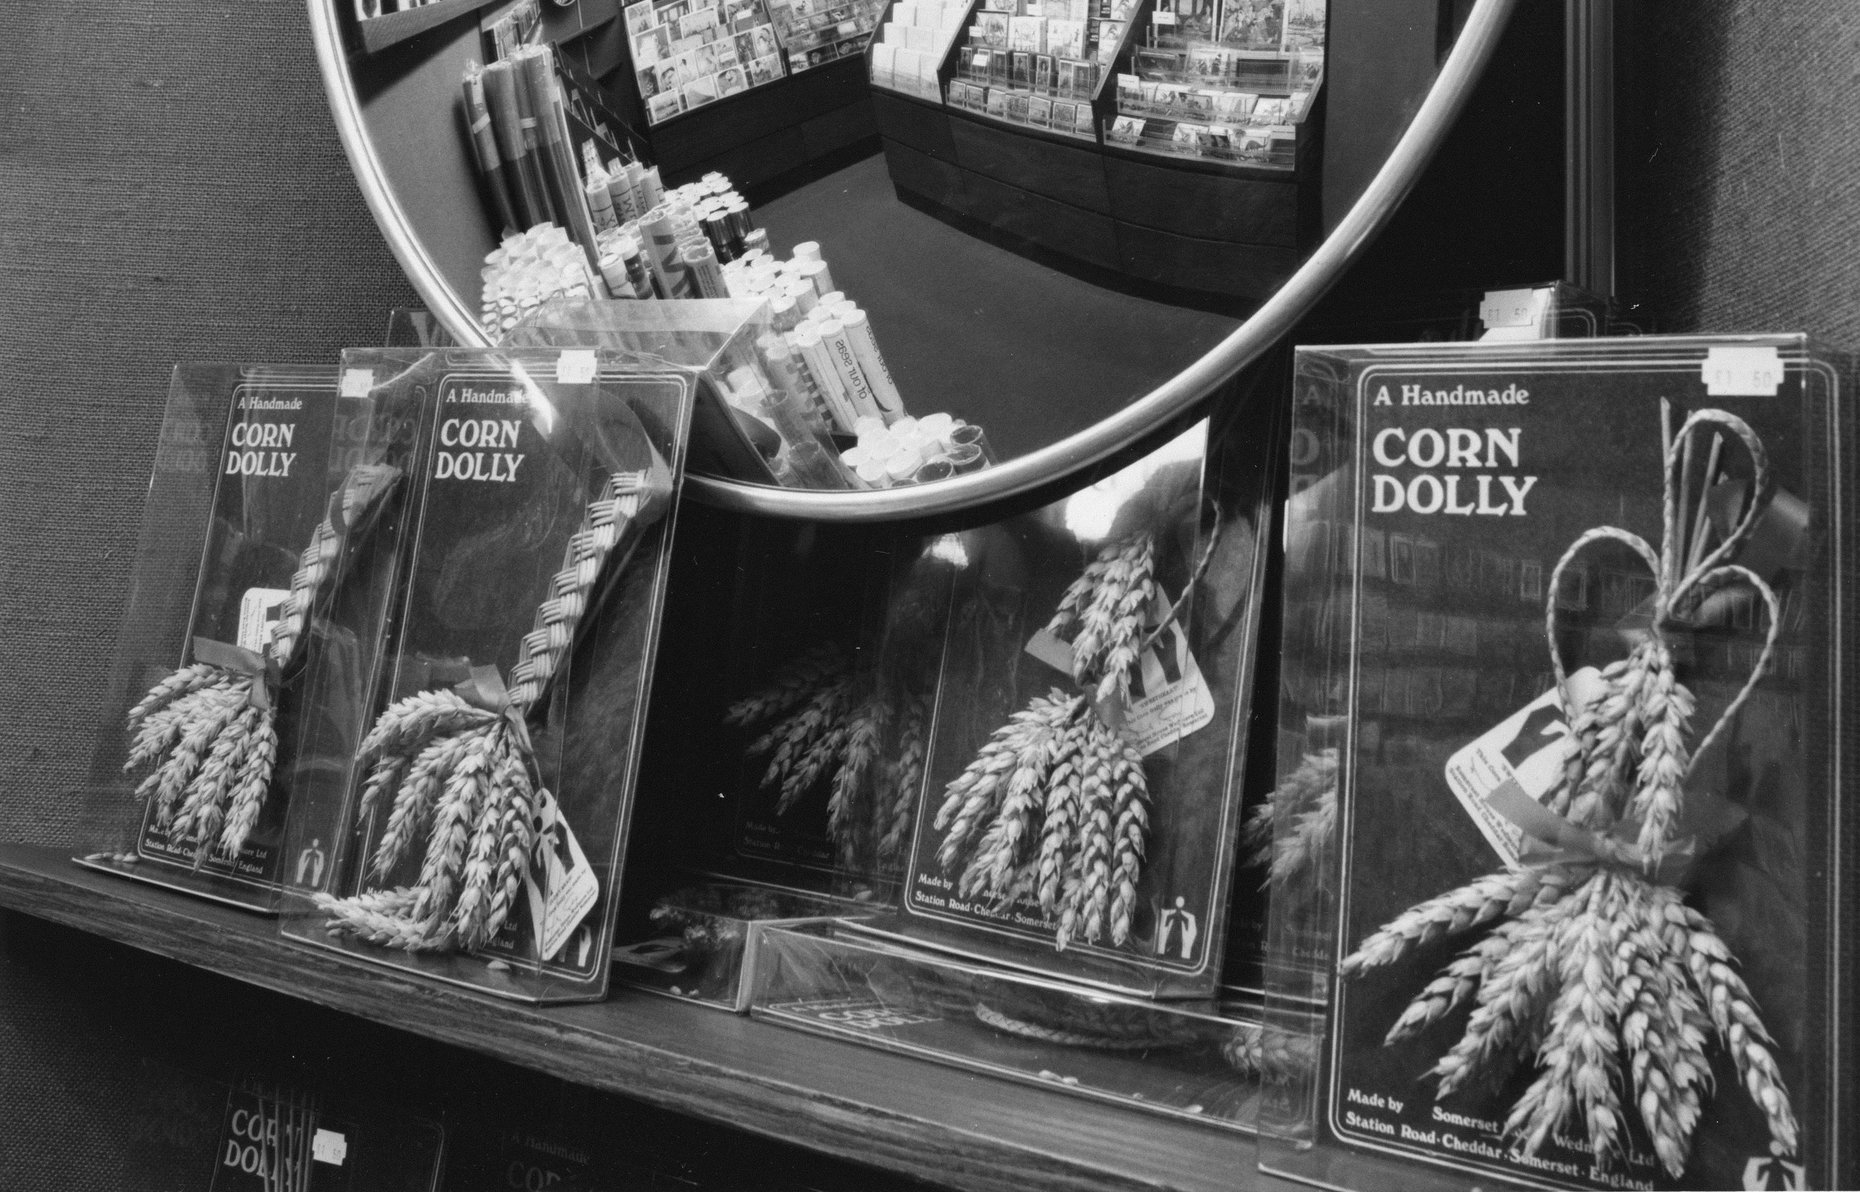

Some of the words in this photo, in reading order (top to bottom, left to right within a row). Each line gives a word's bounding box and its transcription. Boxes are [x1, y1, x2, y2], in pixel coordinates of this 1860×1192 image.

[237, 397, 247, 409] A
[249, 396, 303, 410] Handmade
[446, 389, 456, 403] A
[460, 389, 529, 404] Handmade
[1373, 385, 1392, 405] A
[1401, 384, 1530, 405] Handmade
[231, 423, 296, 447] CORN
[440, 419, 522, 448] CORN
[1373, 427, 1522, 468] CORN
[224, 451, 297, 477] DOLLY
[435, 453, 525, 482] DOLLY
[1372, 475, 1538, 516] DOLLY
[918, 873, 942, 887] Made
[943, 878, 953, 890] by
[915, 891, 945, 907] Station
[949, 899, 971, 912] Road
[1014, 912, 1057, 930] Somerset
[1347, 1088, 1385, 1108] Made
[1387, 1095, 1404, 1114] by
[1432, 1105, 1499, 1133] Somerset
[1629, 1149, 1655, 1167] Ltd
[1346, 1110, 1395, 1136] Station
[1401, 1124, 1436, 1145] Road
[1442, 1133, 1502, 1159] Cheddar
[1509, 1148, 1579, 1177] Somerset
[1589, 1165, 1655, 1191] England
